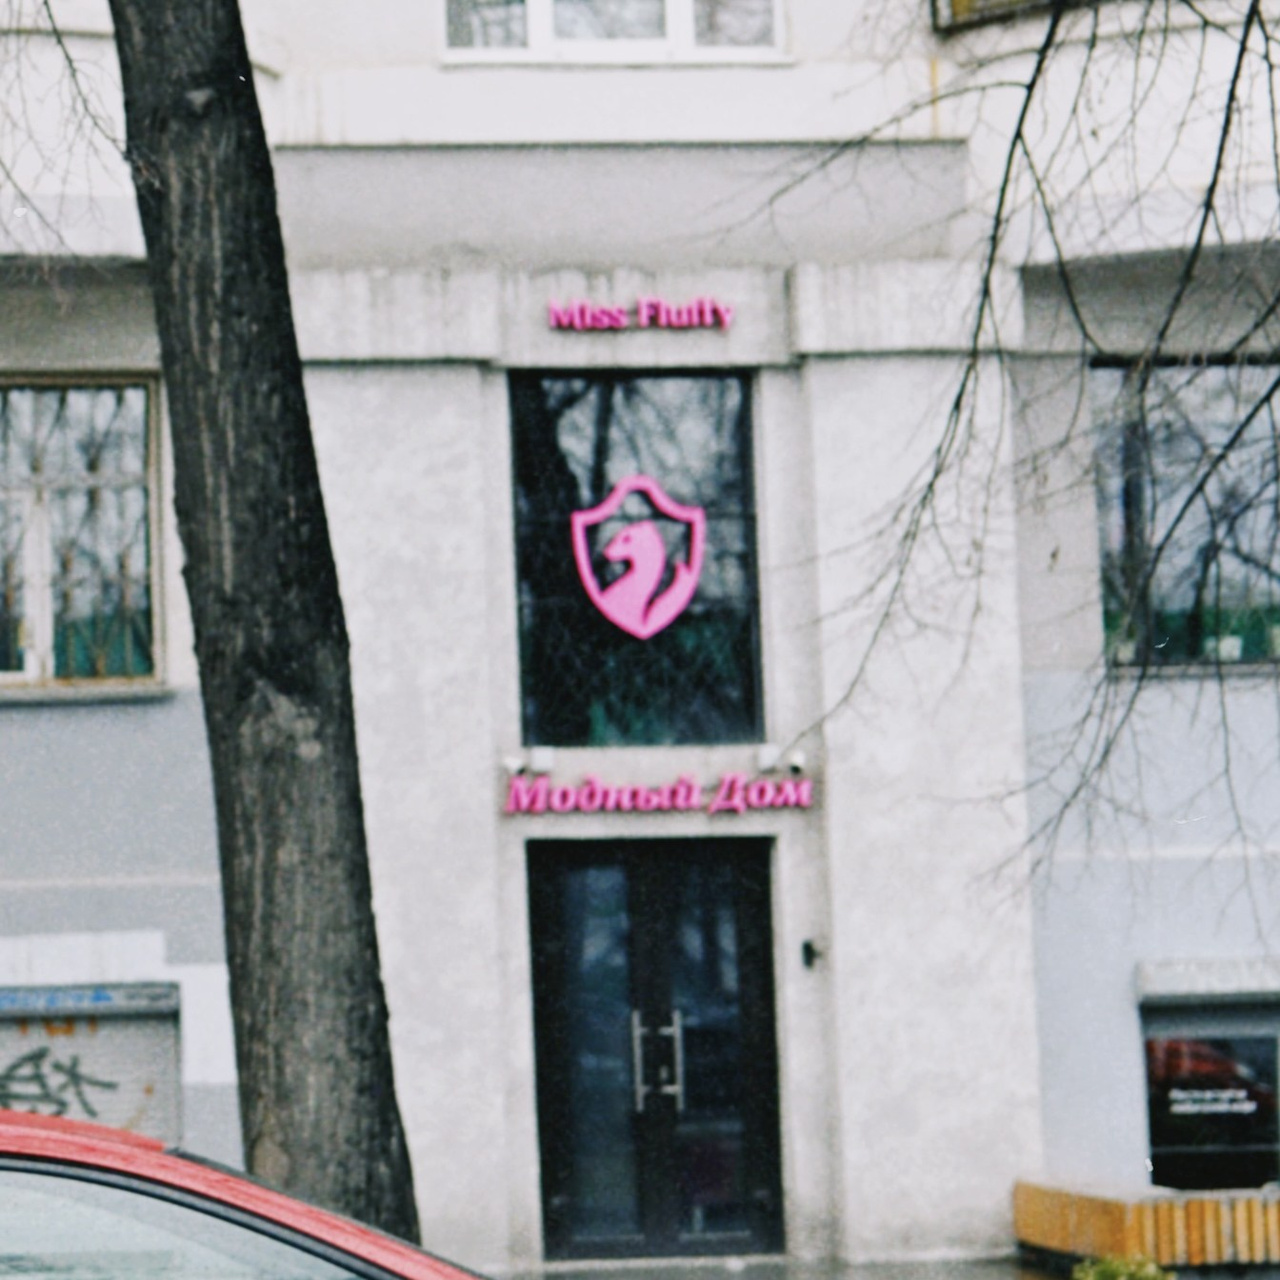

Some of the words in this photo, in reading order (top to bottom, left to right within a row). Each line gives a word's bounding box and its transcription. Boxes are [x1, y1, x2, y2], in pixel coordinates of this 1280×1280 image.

[549, 297, 627, 331] Miss
[506, 774, 701, 814] Модный
[708, 772, 813, 815] Дом
